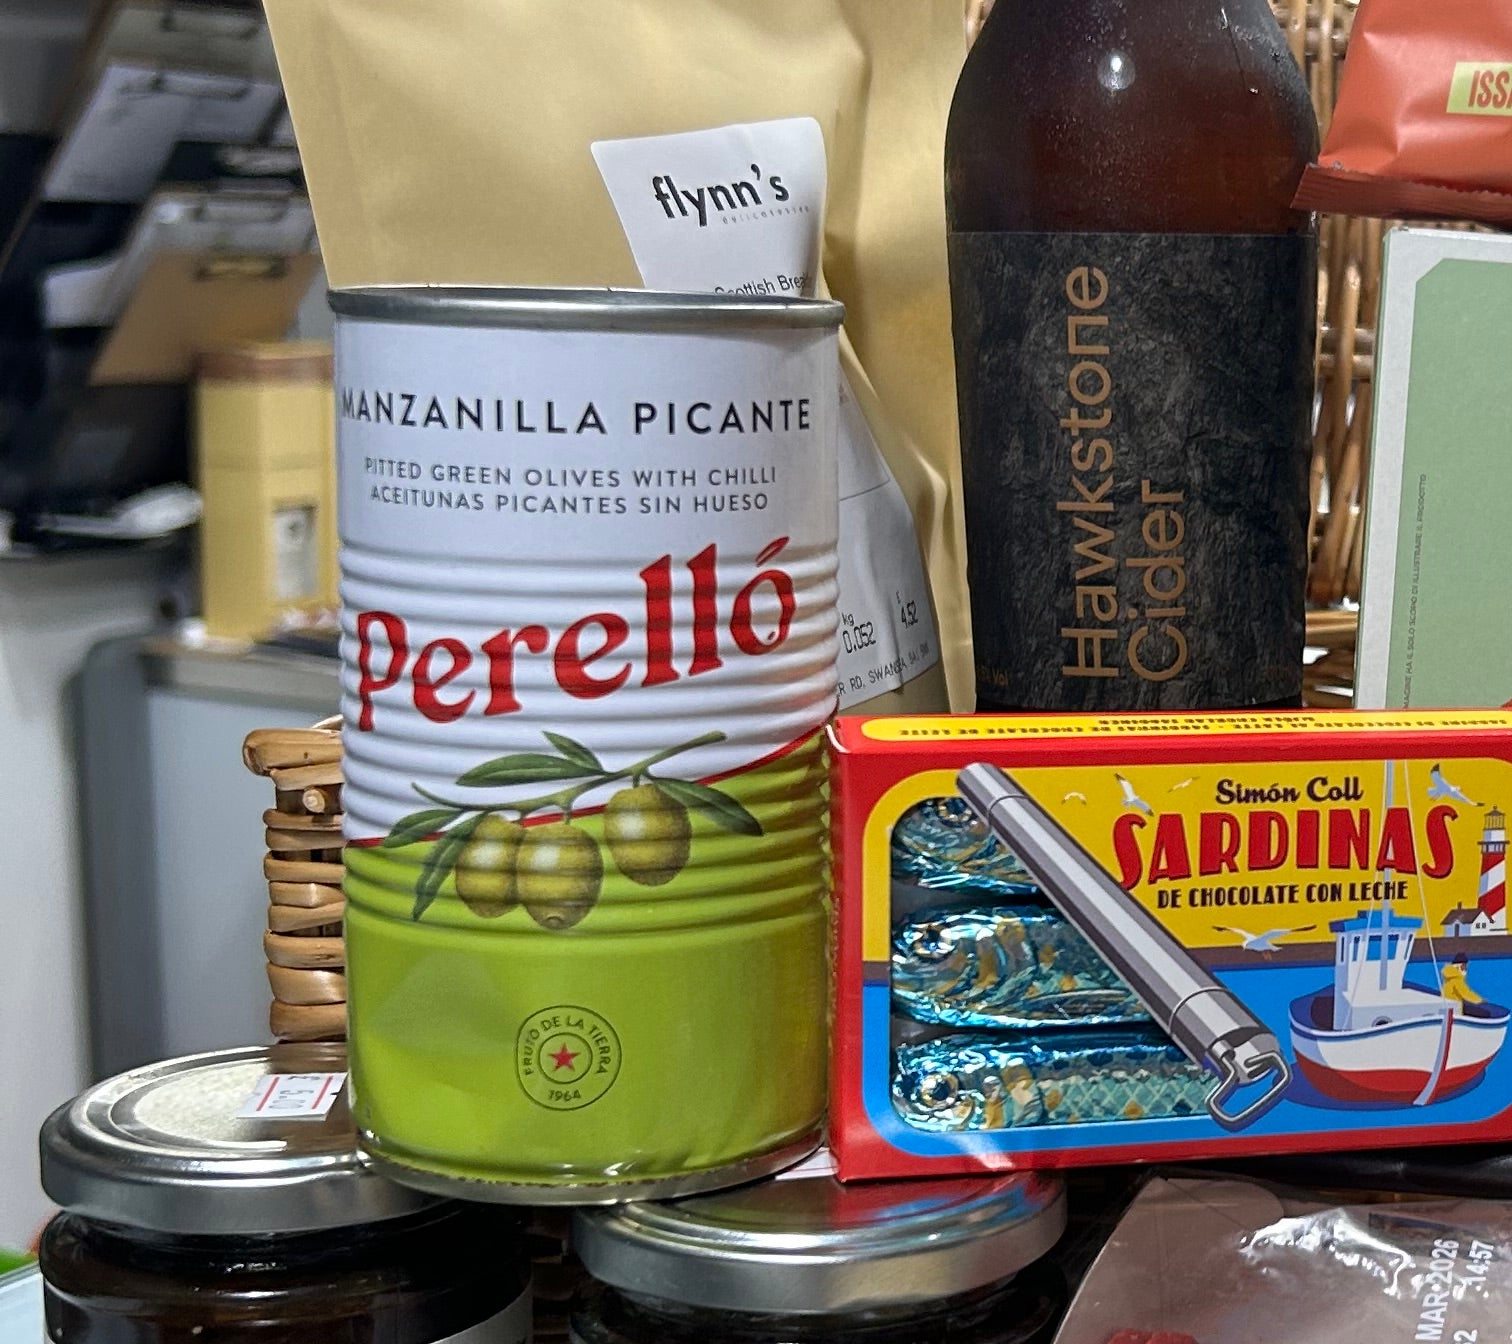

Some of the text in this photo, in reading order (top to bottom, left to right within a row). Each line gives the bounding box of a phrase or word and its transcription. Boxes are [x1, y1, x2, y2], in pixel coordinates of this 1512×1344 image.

[652, 163, 790, 228] flynn's
[342, 386, 811, 436] MANZANILLA PICANTE
[364, 456, 777, 490] PITTED GREEN OLIVES WITH CHILLI
[1055, 264, 1119, 679] Hawkstone
[370, 486, 770, 516] ACEITUNAS PICANTES SIN HUESO
[1126, 477, 1188, 683] Cider
[357, 536, 797, 733] Perelló
[842, 613, 855, 626] kg
[842, 621, 876, 654] 0.052
[901, 600, 918, 629] 4.52
[1215, 777, 1363, 808] Simón Coll
[1112, 806, 1459, 891] SARDINAS
[1157, 880, 1409, 910] DE CHOCOLATE CON LECHE
[540, 1016, 561, 1031] DE
[566, 1015, 584, 1030] LA
[588, 1024, 611, 1074] TIERRA
[548, 1088, 582, 1101] 1964
[1425, 1238, 1460, 1288] 2026
[1415, 1290, 1450, 1341] MAR
